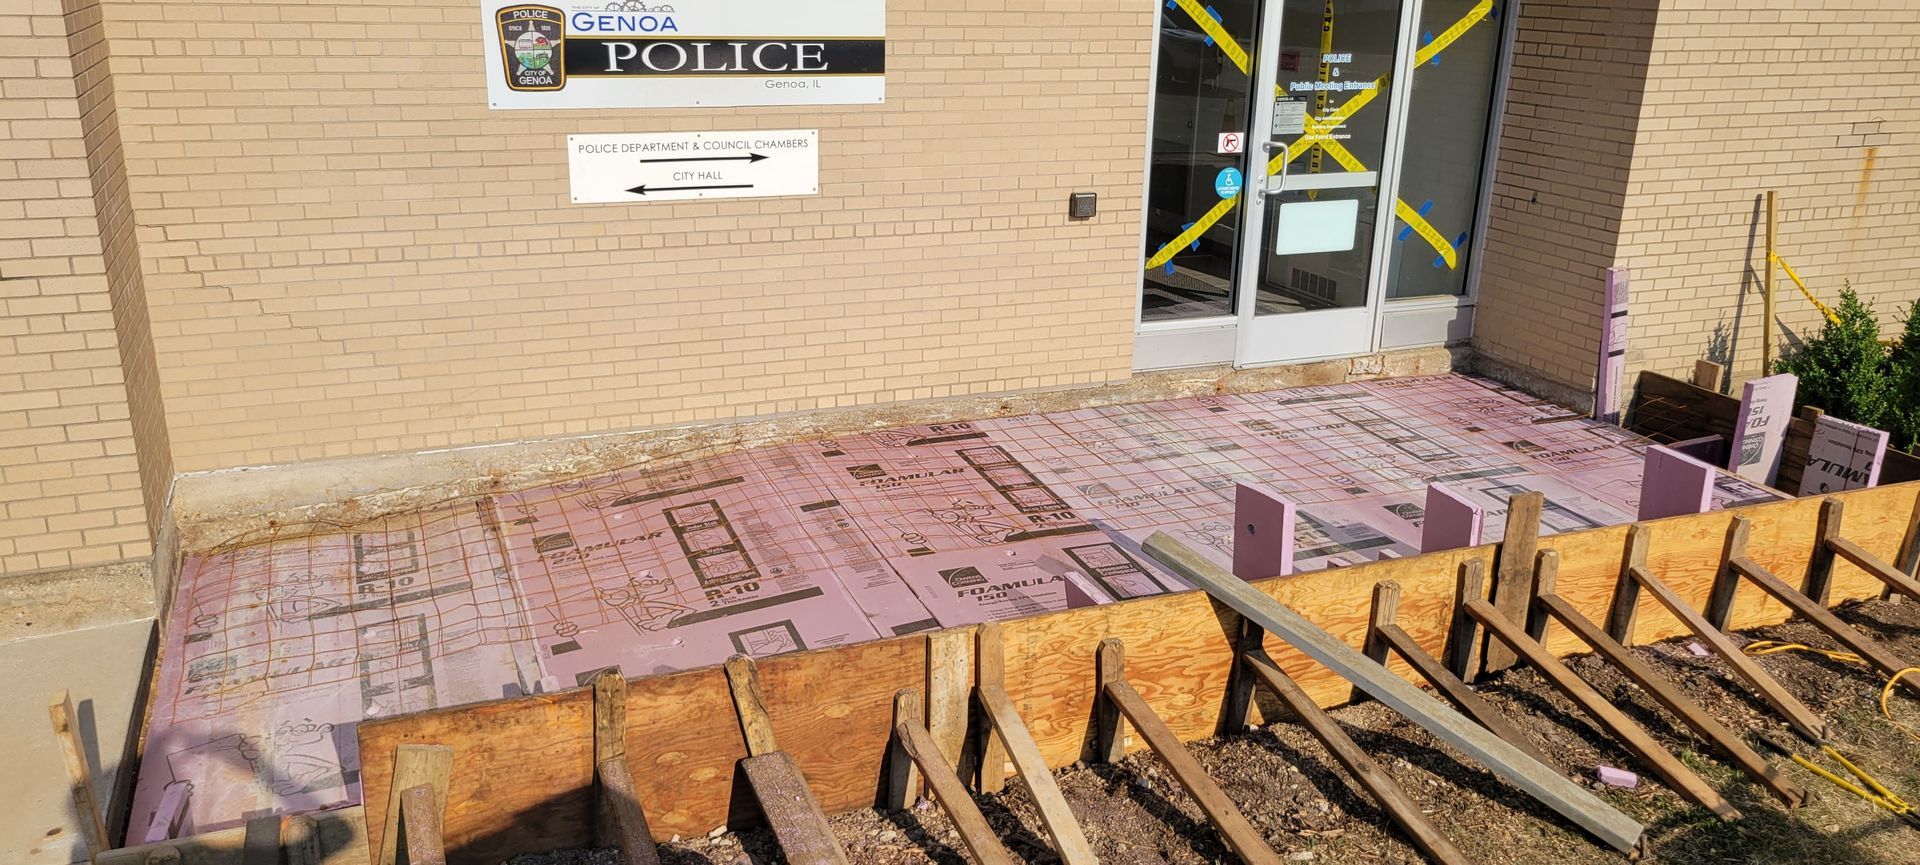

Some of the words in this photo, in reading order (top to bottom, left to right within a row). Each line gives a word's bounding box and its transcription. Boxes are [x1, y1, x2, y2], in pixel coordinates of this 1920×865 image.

[513, 9, 549, 19] POLICE
[572, 12, 678, 32] GENOA
[601, 42, 829, 72] POLICE
[1322, 53, 1352, 63] POLICE
[1332, 67, 1340, 77] &
[519, 76, 553, 85] GENOA
[765, 79, 809, 89] Genoa,
[813, 79, 821, 88] IL
[1289, 81, 1314, 92] Public
[1314, 81, 1343, 92] Meeting
[1343, 80, 1376, 91] Entrance
[578, 143, 618, 154] POLICE
[621, 141, 690, 153] DEPARTMENT
[693, 141, 700, 151] &
[703, 140, 751, 150] COUNCIL
[754, 138, 809, 150] CHAMBERS
[672, 171, 695, 181] CITY
[698, 170, 723, 180] HALL
[928, 423, 971, 433] R-10
[1027, 511, 1077, 524] R-10
[358, 576, 415, 594] R-10
[957, 574, 1065, 598] FOAMULA
[705, 582, 760, 601] R-10
[976, 591, 1007, 602] 150
